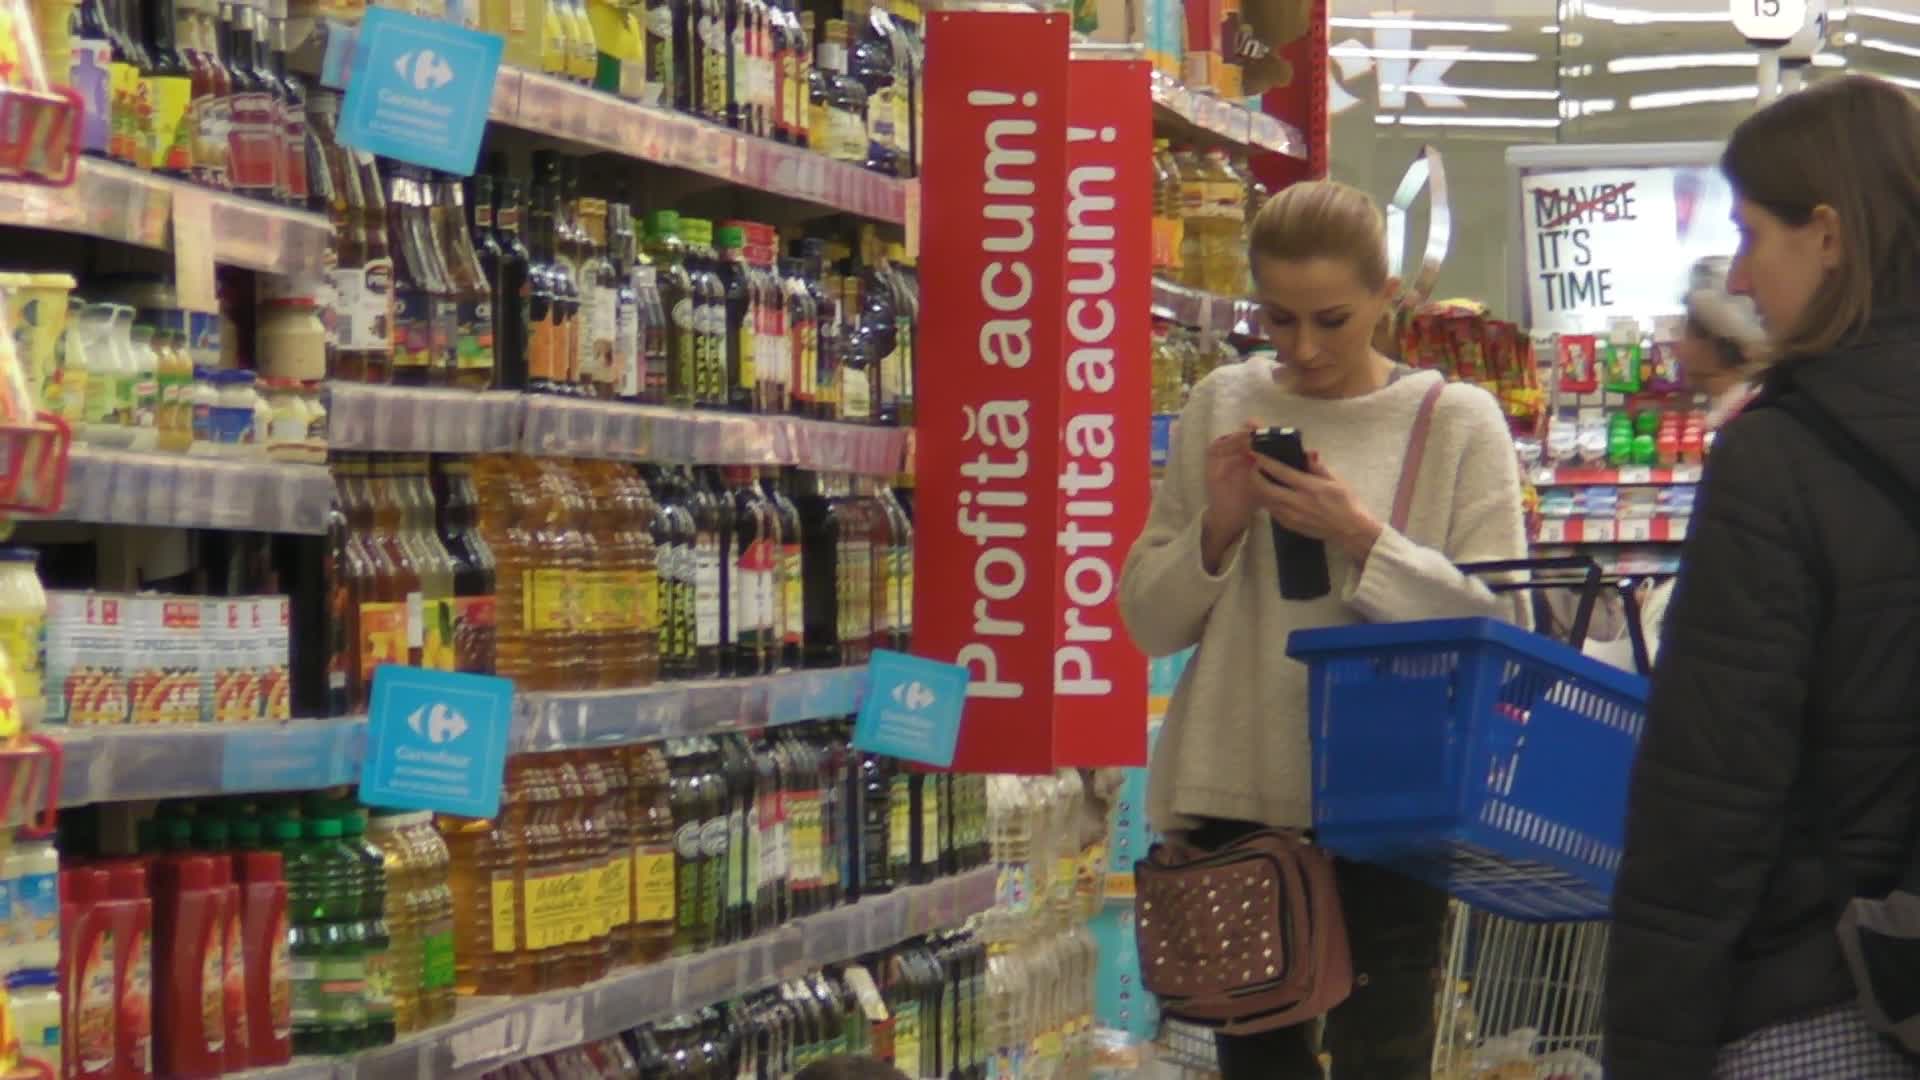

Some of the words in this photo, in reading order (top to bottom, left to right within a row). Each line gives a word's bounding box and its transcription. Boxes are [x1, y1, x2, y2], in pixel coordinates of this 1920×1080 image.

[1534, 183, 1638, 228] MAYBE
[967, 89, 1040, 369] acum!
[1537, 228, 1593, 270] IT'S
[1540, 269, 1615, 312] TIME
[958, 398, 1031, 700] Profită
